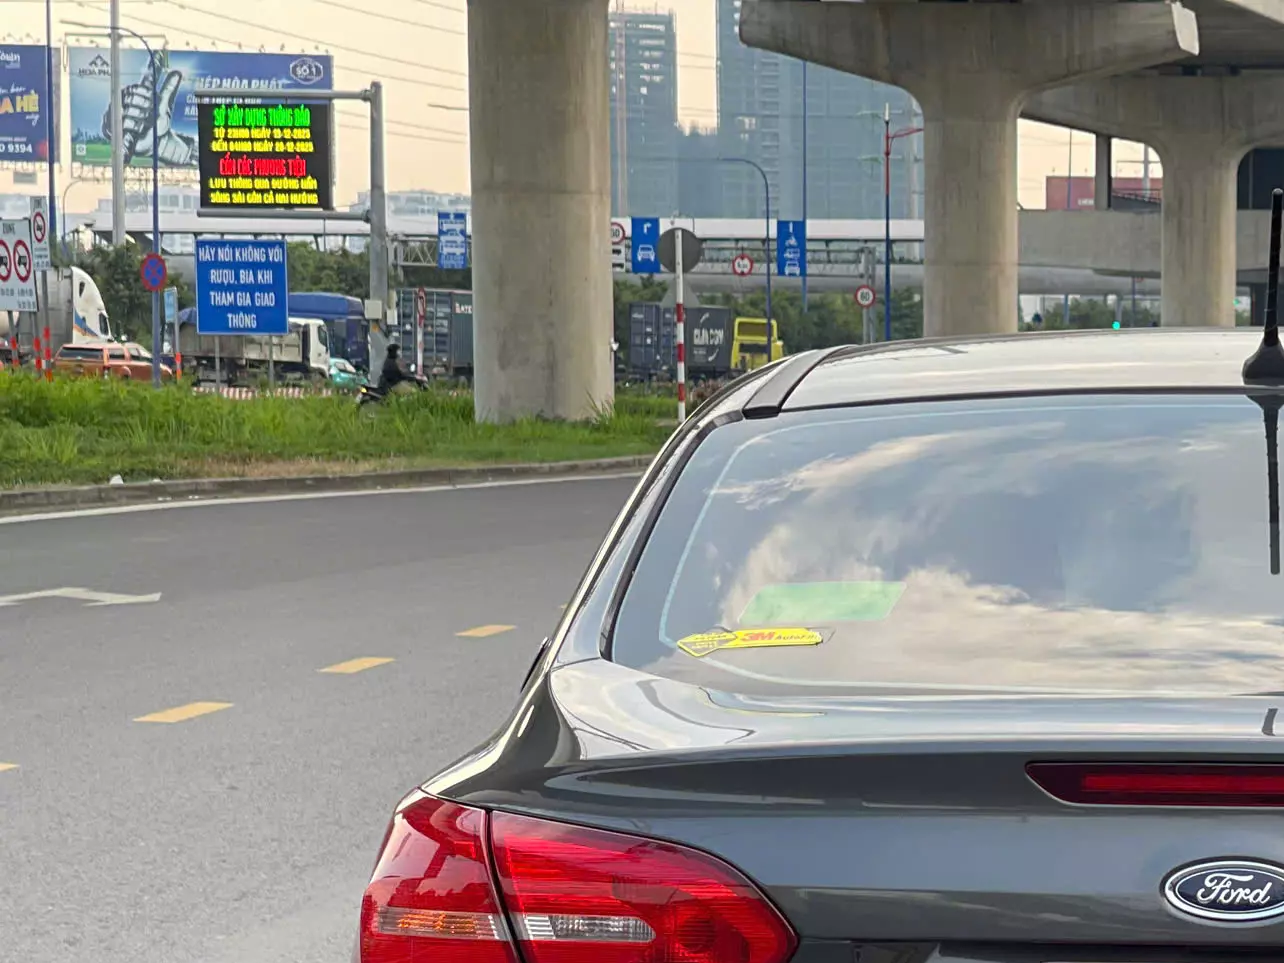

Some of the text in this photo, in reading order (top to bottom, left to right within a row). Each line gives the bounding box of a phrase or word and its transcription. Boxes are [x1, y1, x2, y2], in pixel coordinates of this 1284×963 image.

[217, 244, 233, 262] NÓI
[235, 245, 266, 262] KHÔNG
[268, 244, 283, 263] VỚI
[240, 269, 255, 284] BIA
[257, 269, 273, 284] KHI
[209, 291, 276, 307] THAM GIA GIAO
[227, 311, 257, 329] THÔNG
[741, 631, 775, 643] 3M
[1197, 872, 1273, 904] Ford
